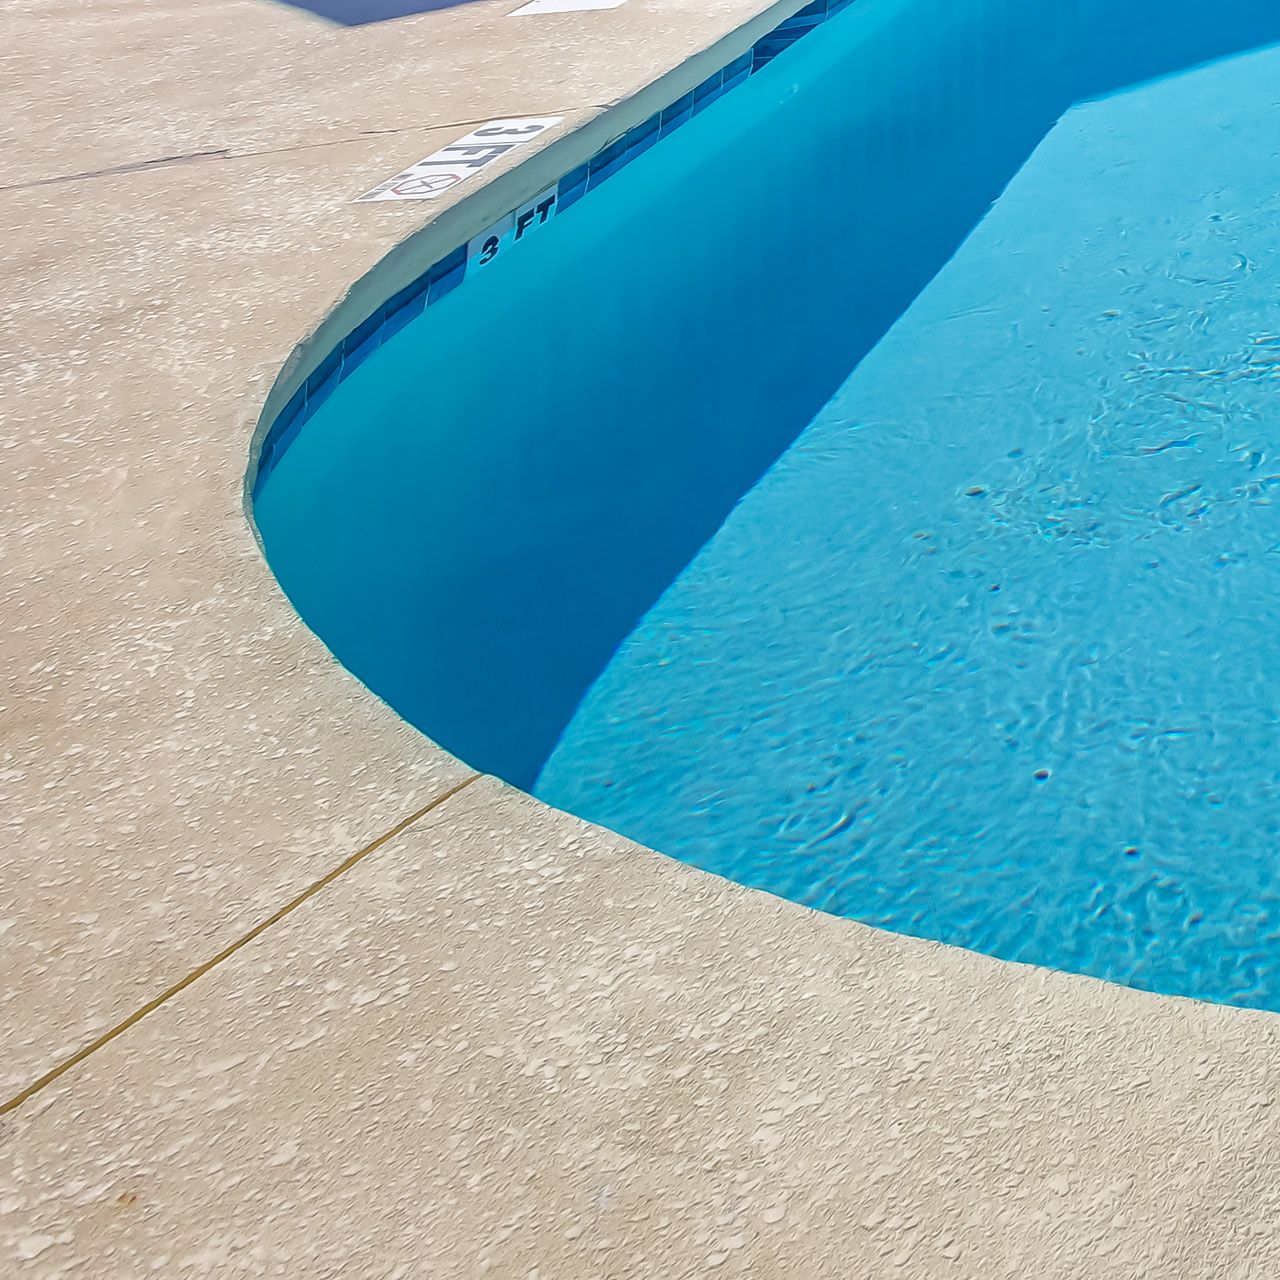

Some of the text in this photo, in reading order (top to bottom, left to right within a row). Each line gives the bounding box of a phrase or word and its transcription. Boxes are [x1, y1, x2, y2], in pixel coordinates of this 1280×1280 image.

[416, 124, 545, 168] 3 FT
[479, 194, 556, 266] 3 FT
